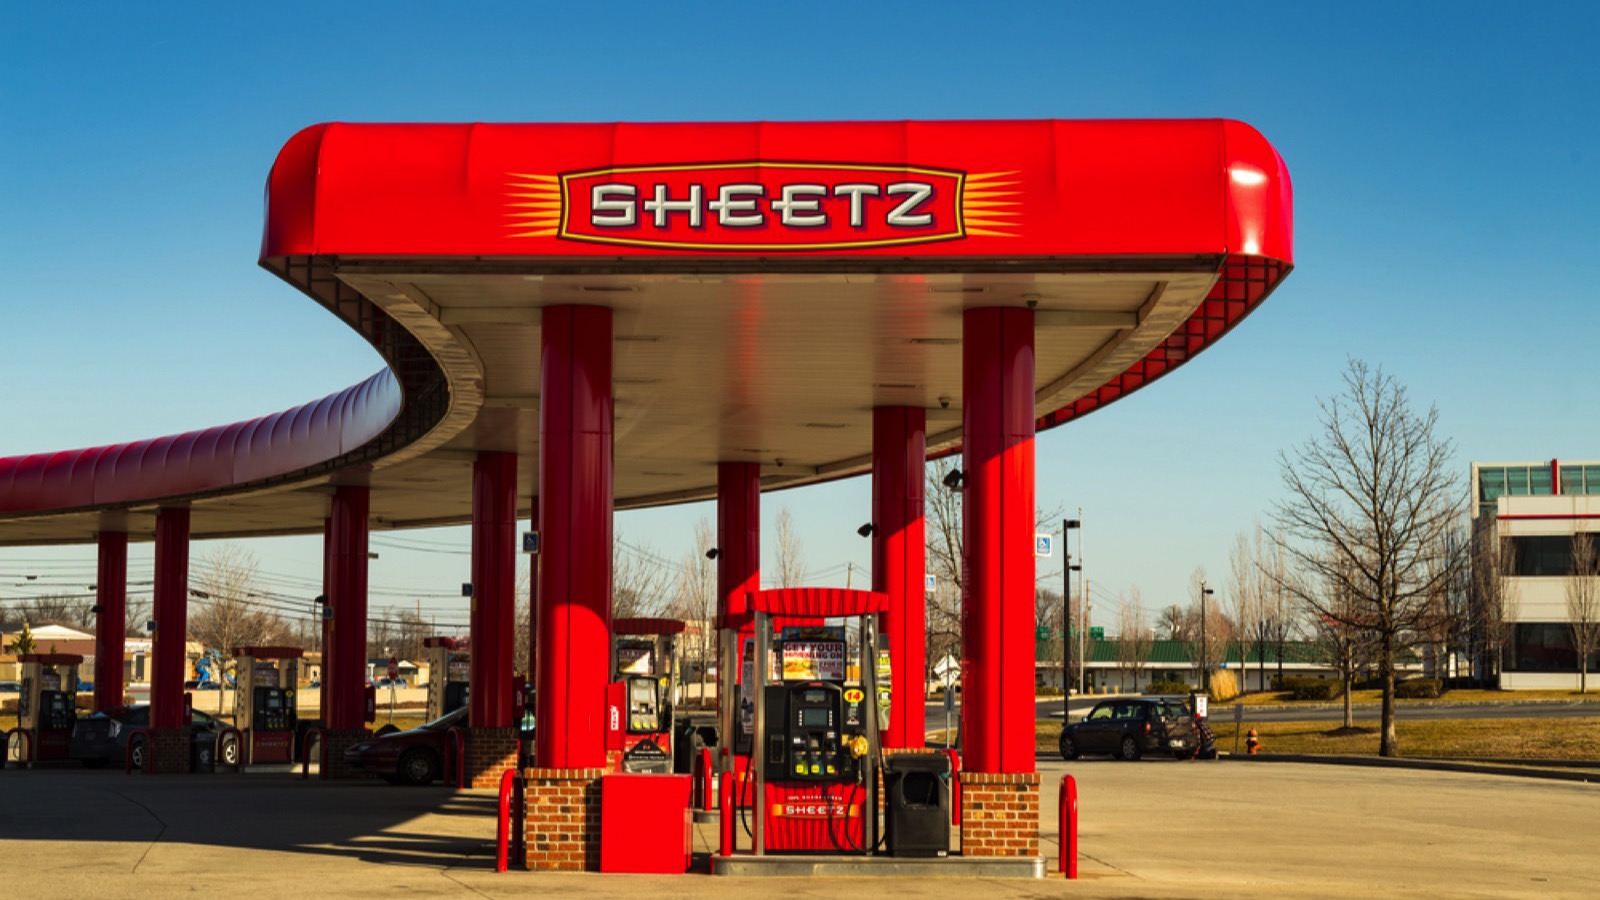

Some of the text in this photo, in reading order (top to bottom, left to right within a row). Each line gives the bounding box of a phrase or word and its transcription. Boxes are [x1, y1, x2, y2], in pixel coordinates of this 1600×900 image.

[590, 183, 935, 228] SHEETZ
[785, 643, 843, 651] GET YOUR
[830, 651, 843, 659] ON
[847, 691, 861, 701] 14
[786, 805, 844, 815] SHEETZ
